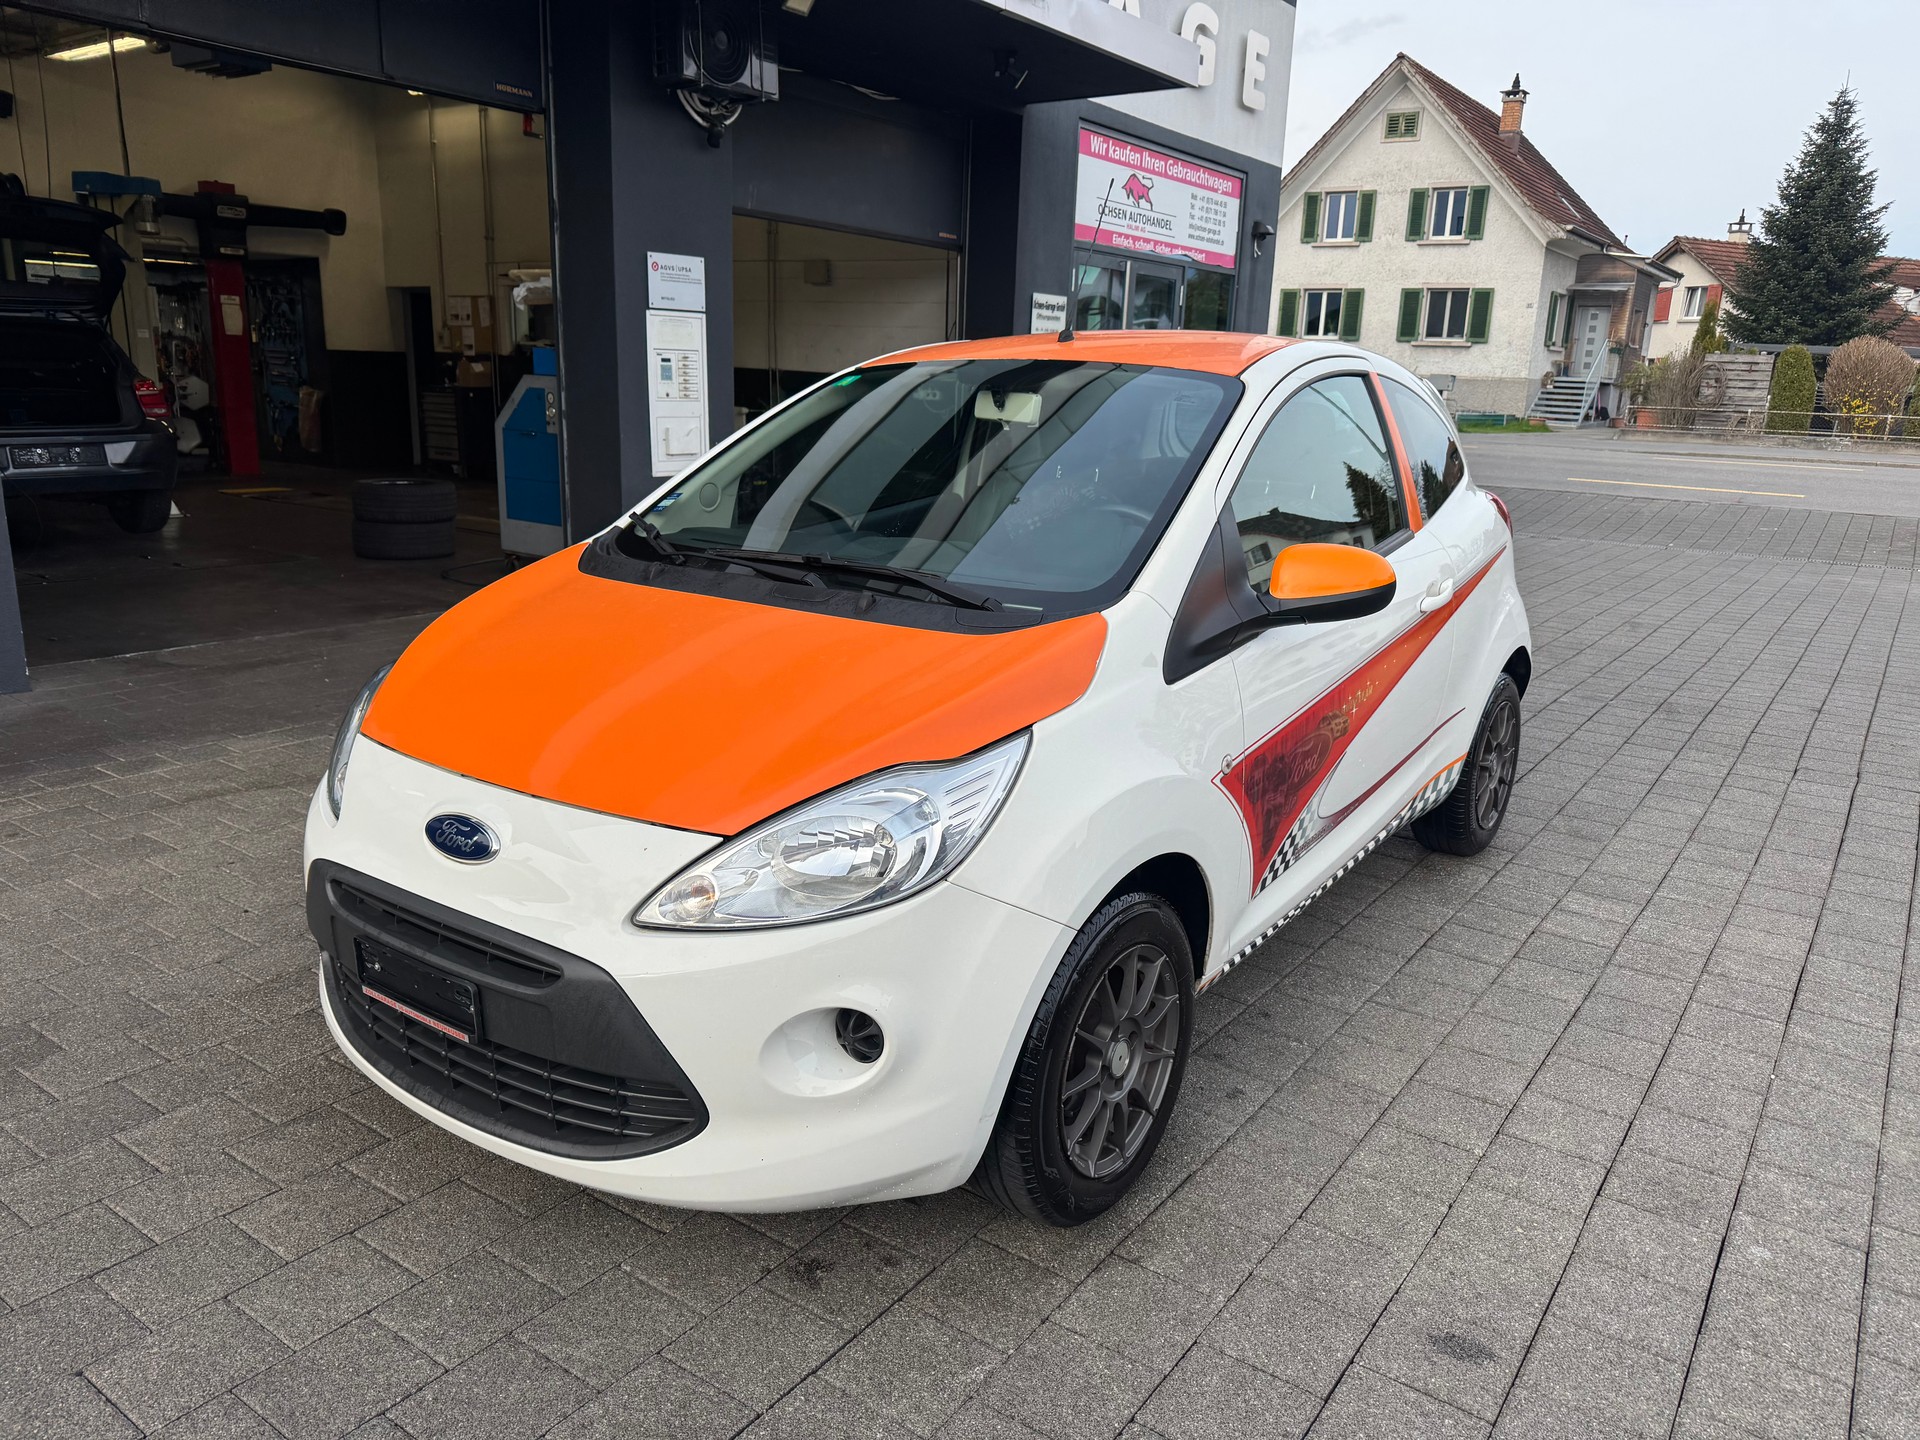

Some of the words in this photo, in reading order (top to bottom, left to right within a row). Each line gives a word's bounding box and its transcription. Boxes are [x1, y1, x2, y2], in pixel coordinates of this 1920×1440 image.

[1090, 135, 1108, 155] Wir
[1109, 140, 1141, 167] kaufen
[1142, 151, 1165, 174] Ihren
[1166, 160, 1232, 194] Gebrauchtwagen
[1097, 203, 1127, 220] OCHSEN
[1129, 211, 1173, 231] AUTOHANDEL
[1112, 234, 1134, 249] Einfach,
[436, 820, 479, 853] Ford
